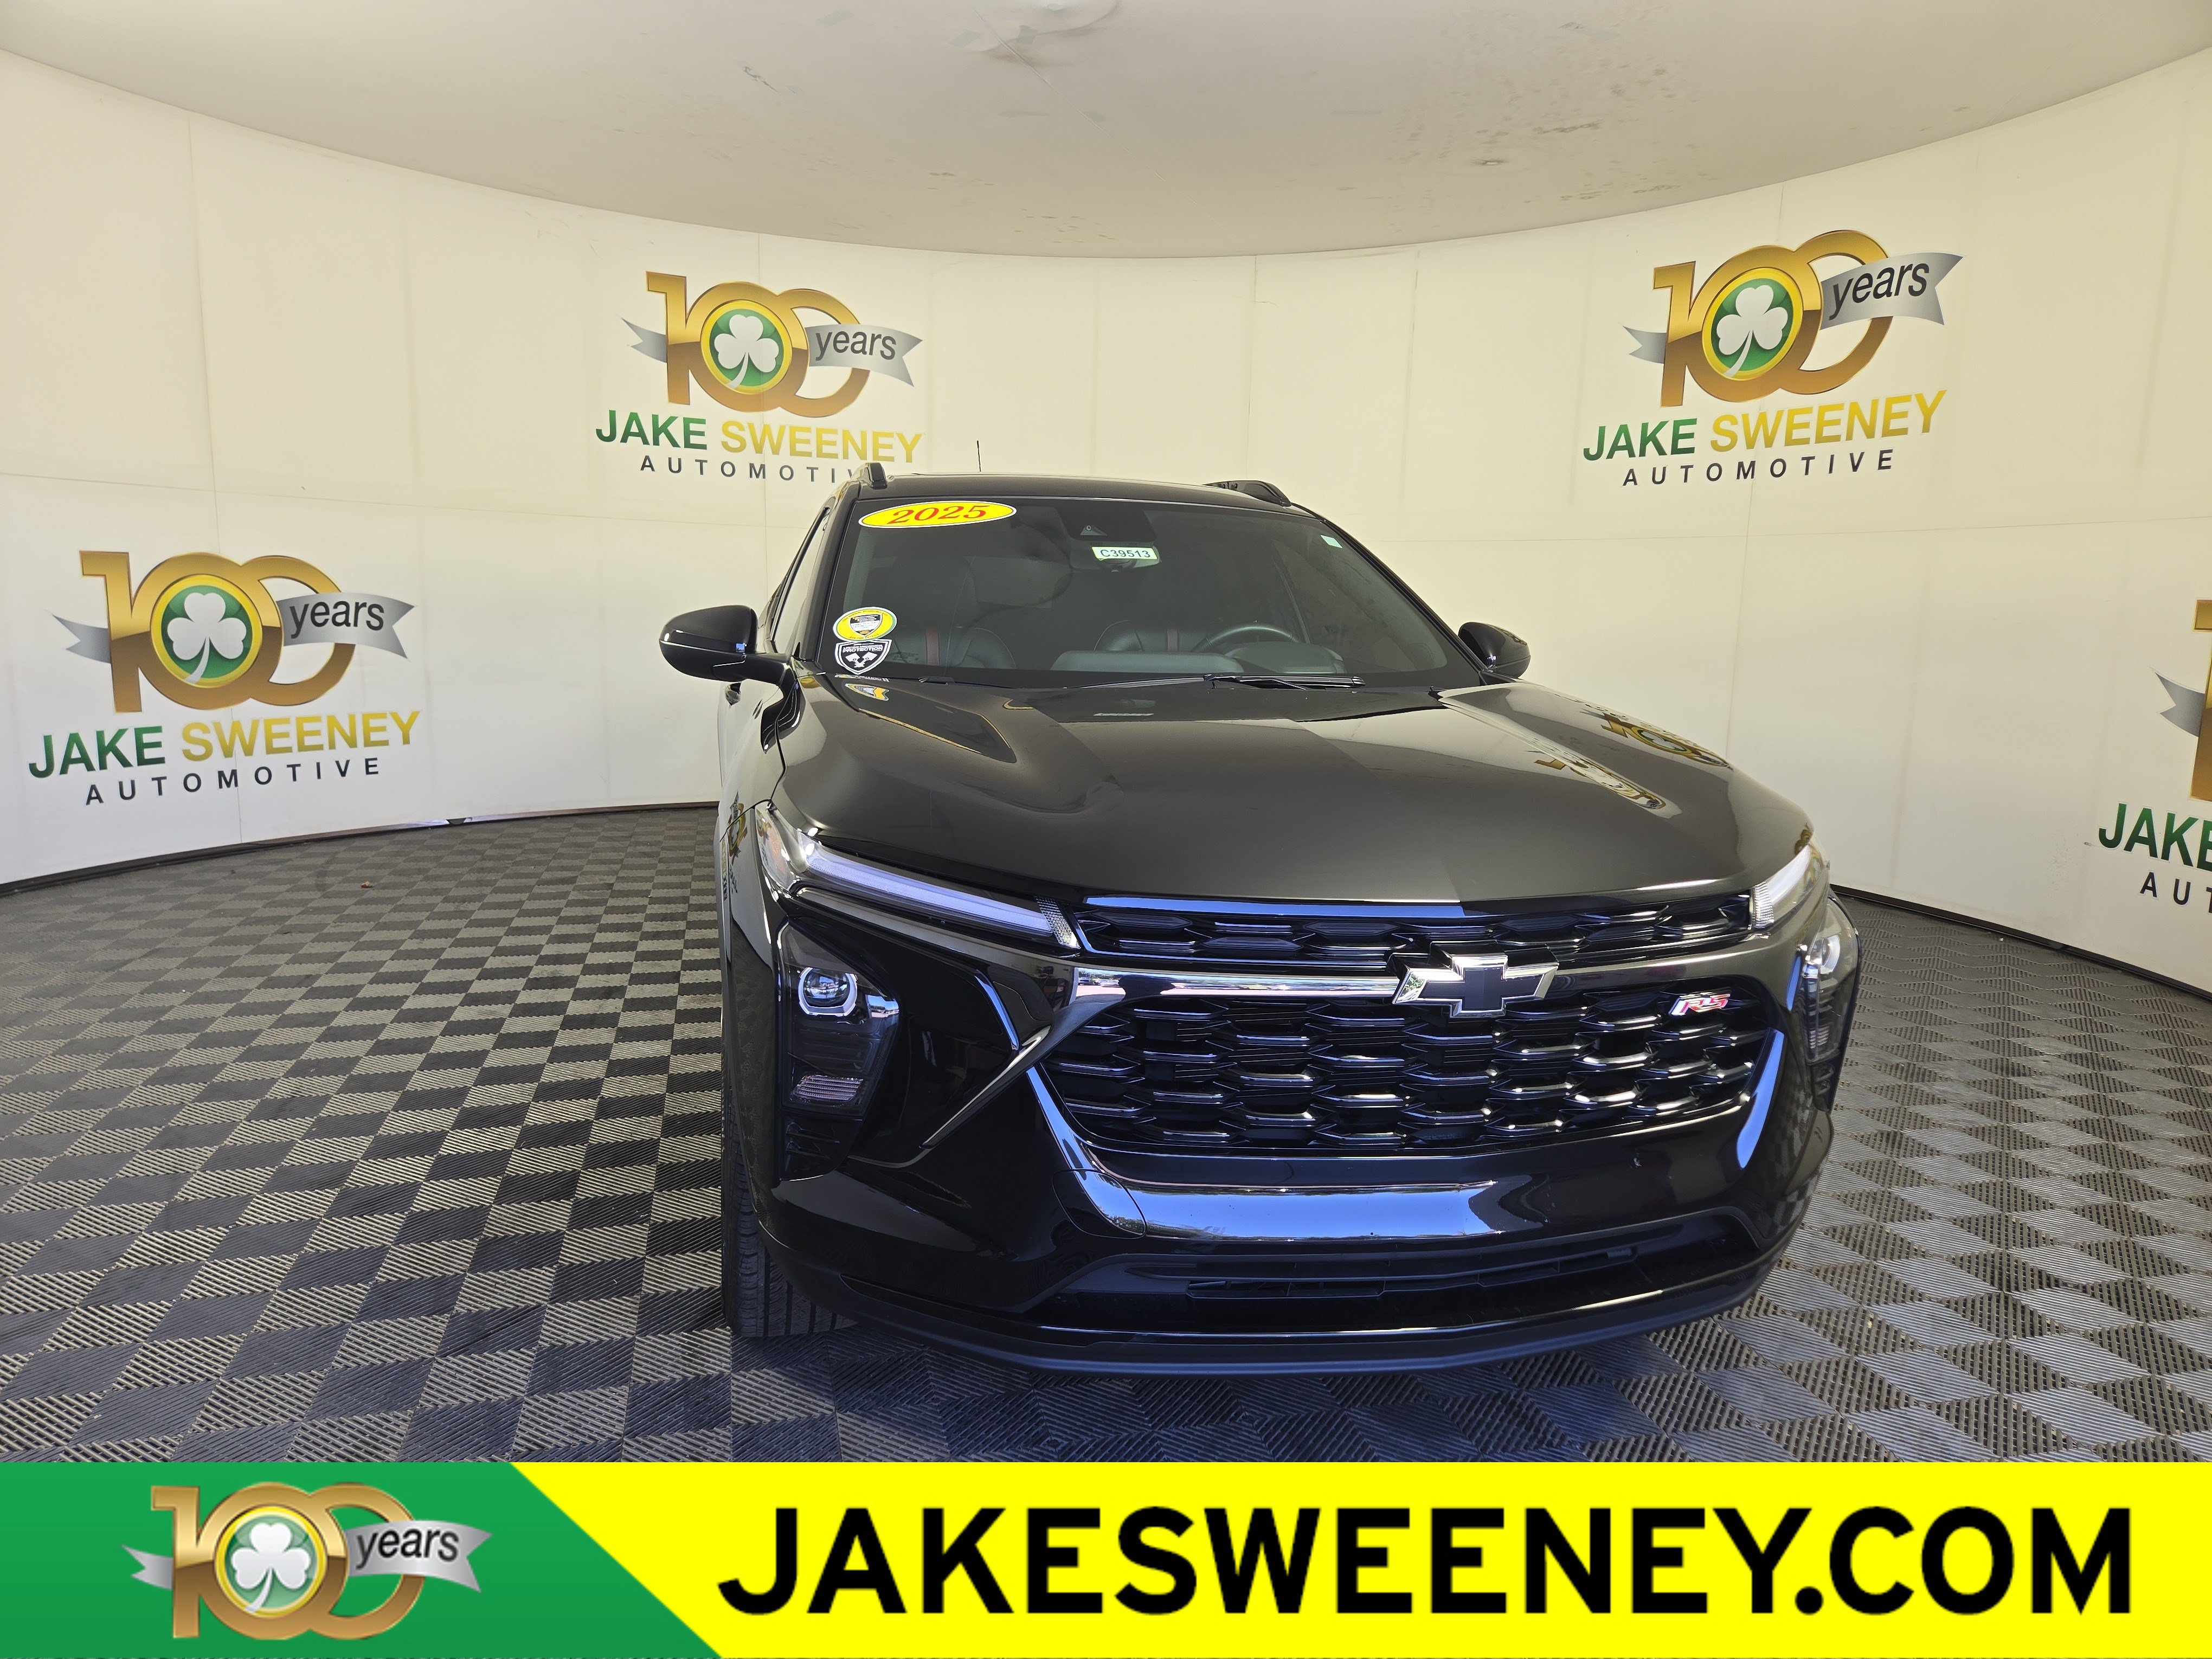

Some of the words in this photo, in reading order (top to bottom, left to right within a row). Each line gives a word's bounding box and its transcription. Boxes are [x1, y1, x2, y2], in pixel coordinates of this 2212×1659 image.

[1829, 262, 1930, 320] years
[1653, 229, 1893, 407] 100
[646, 271, 871, 417] 100
[815, 329, 897, 361] years
[596, 410, 707, 450] JAKE
[721, 420, 922, 463] SWEENEY
[1583, 418, 1697, 461] JAKE
[1710, 390, 1947, 452] SWEENEY
[640, 455, 853, 484] AUTOMOTI
[1623, 449, 1893, 486] AUTOMOTIVE
[886, 505, 990, 524] 2025
[1100, 549, 1150, 557] C39513
[79, 550, 356, 713] 100
[290, 600, 384, 639] years
[28, 725, 166, 779] JAKE
[182, 711, 421, 762] SWEENEY
[86, 758, 379, 806] AUTOMOTIVE
[1669, 993, 1731, 1015] RS
